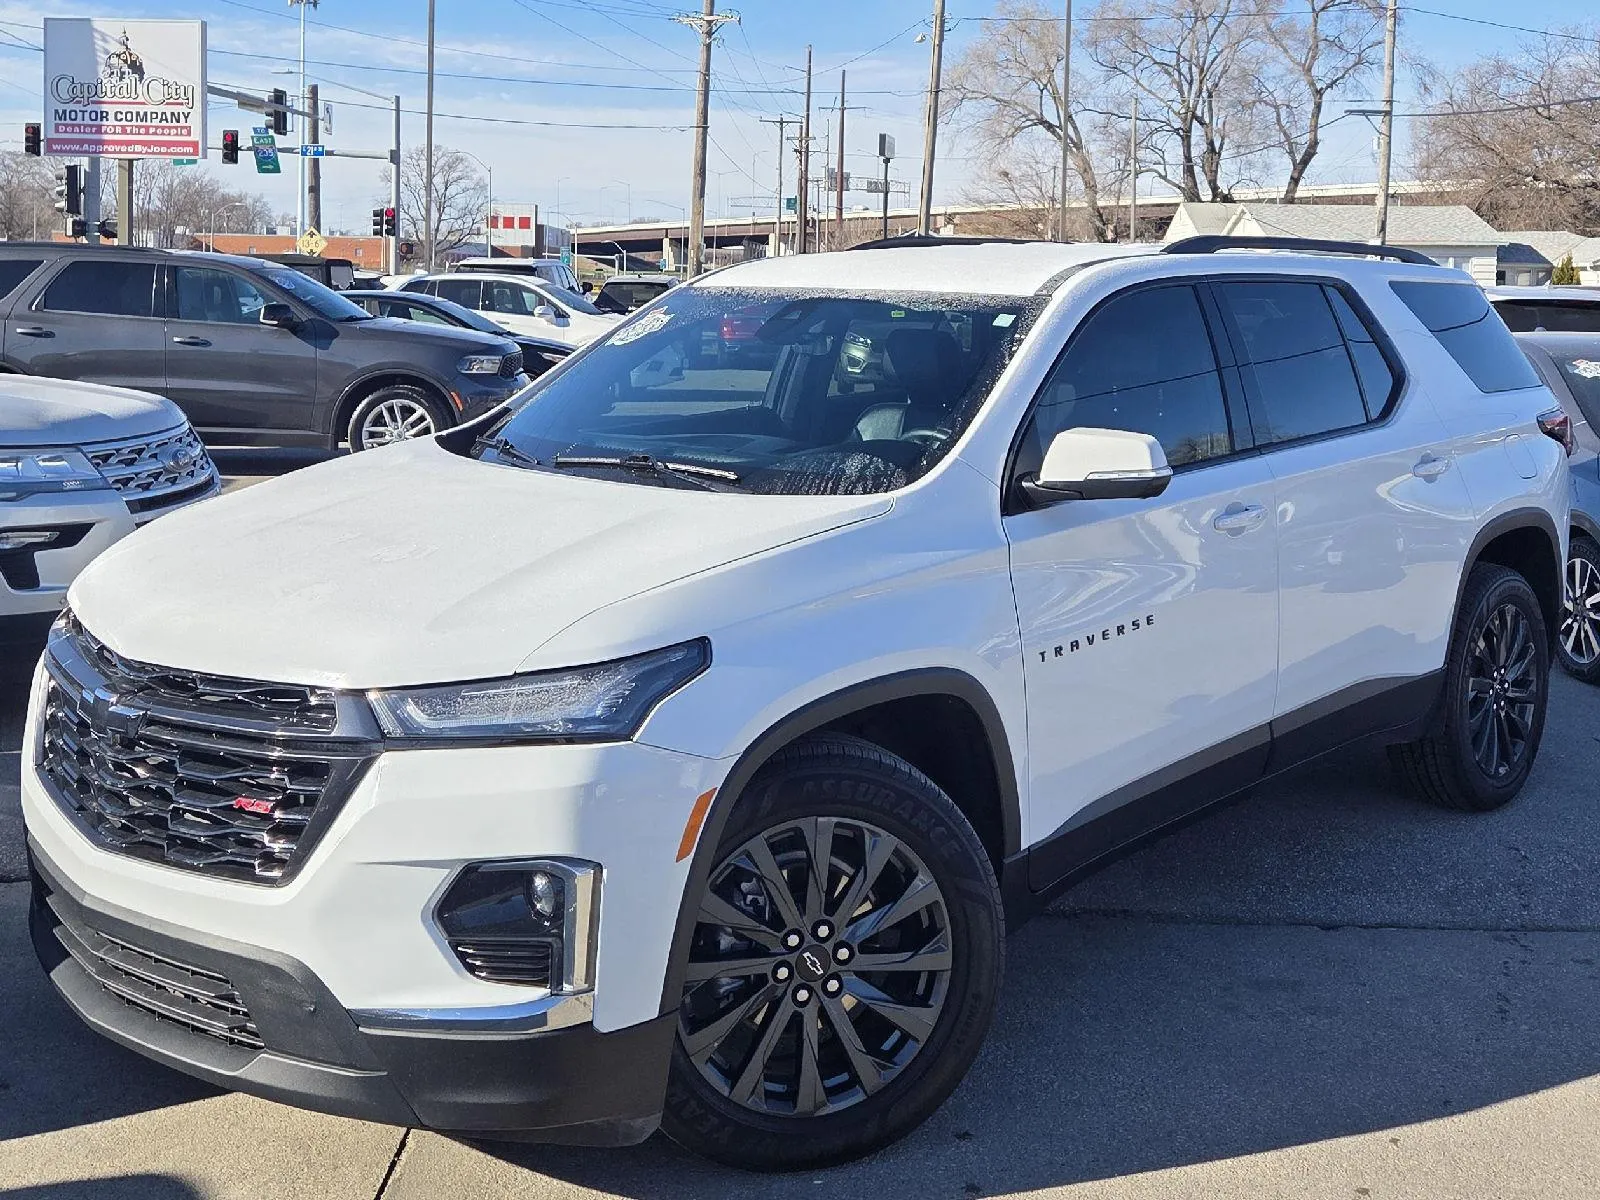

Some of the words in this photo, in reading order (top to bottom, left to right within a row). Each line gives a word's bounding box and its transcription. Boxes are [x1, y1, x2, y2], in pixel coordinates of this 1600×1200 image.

[50, 75, 139, 106] Capital
[142, 76, 194, 109] City
[54, 109, 109, 122] MOTOR
[114, 111, 191, 123] COMPANY
[58, 125, 97, 133] Dealer
[101, 125, 122, 134] FOR
[126, 126, 145, 134] The
[149, 126, 188, 135] People
[253, 136, 272, 144] EAST
[1039, 614, 1155, 663] TRAVERSE
